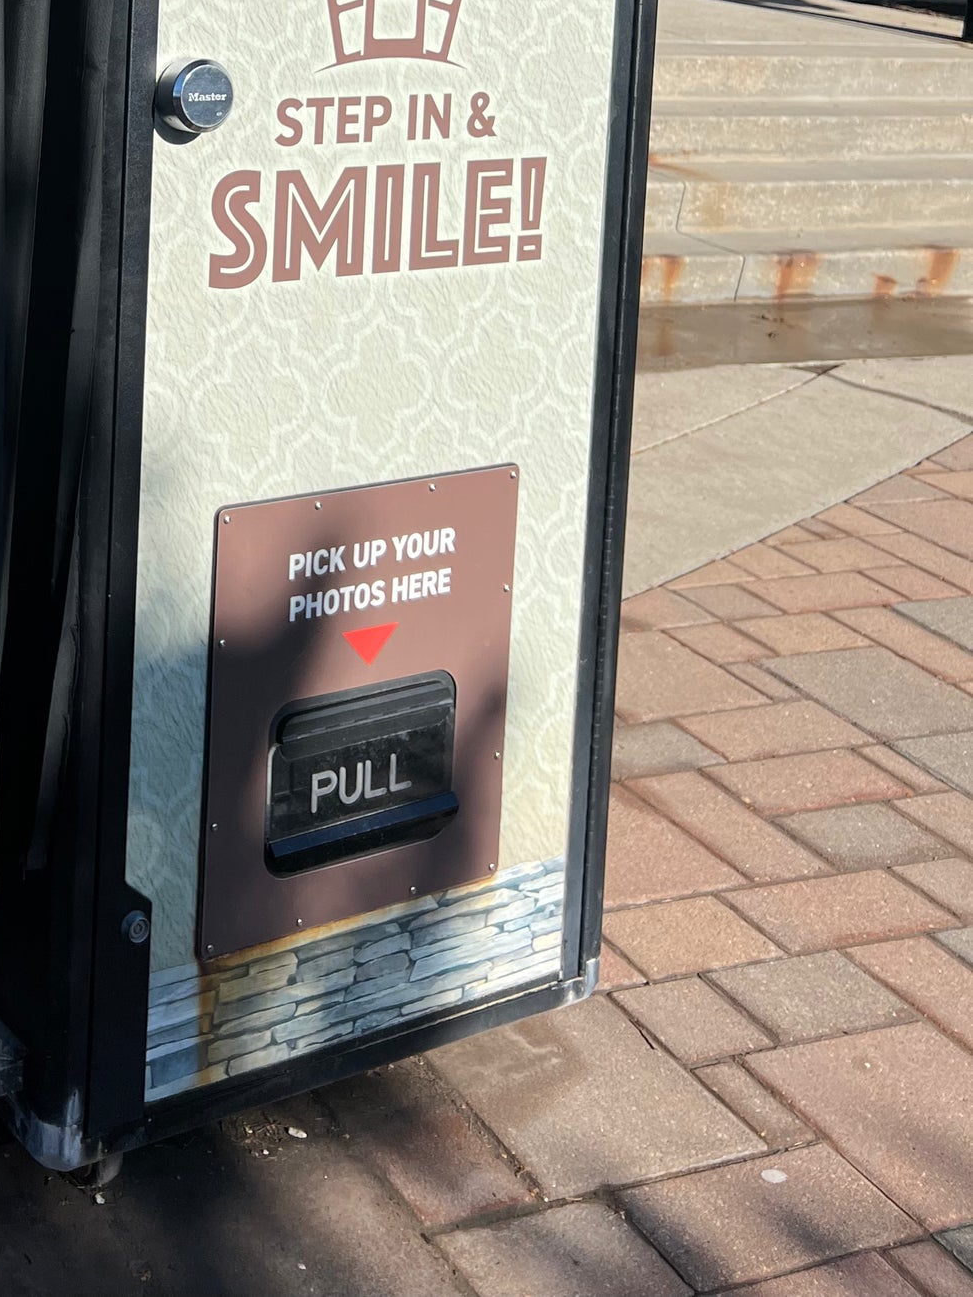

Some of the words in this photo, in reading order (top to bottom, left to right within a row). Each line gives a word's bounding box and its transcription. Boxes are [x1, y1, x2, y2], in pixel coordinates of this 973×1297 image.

[188, 92, 227, 102] Master
[275, 95, 392, 146] STEP
[407, 93, 452, 140] IN
[467, 92, 497, 137] &
[209, 156, 547, 289] SMILE!
[288, 546, 346, 580] PICK
[353, 539, 386, 568] UP
[392, 527, 456, 562] YOUR
[288, 578, 385, 622] PHOTOS
[391, 567, 452, 603] HERE
[310, 753, 412, 814] PULL
